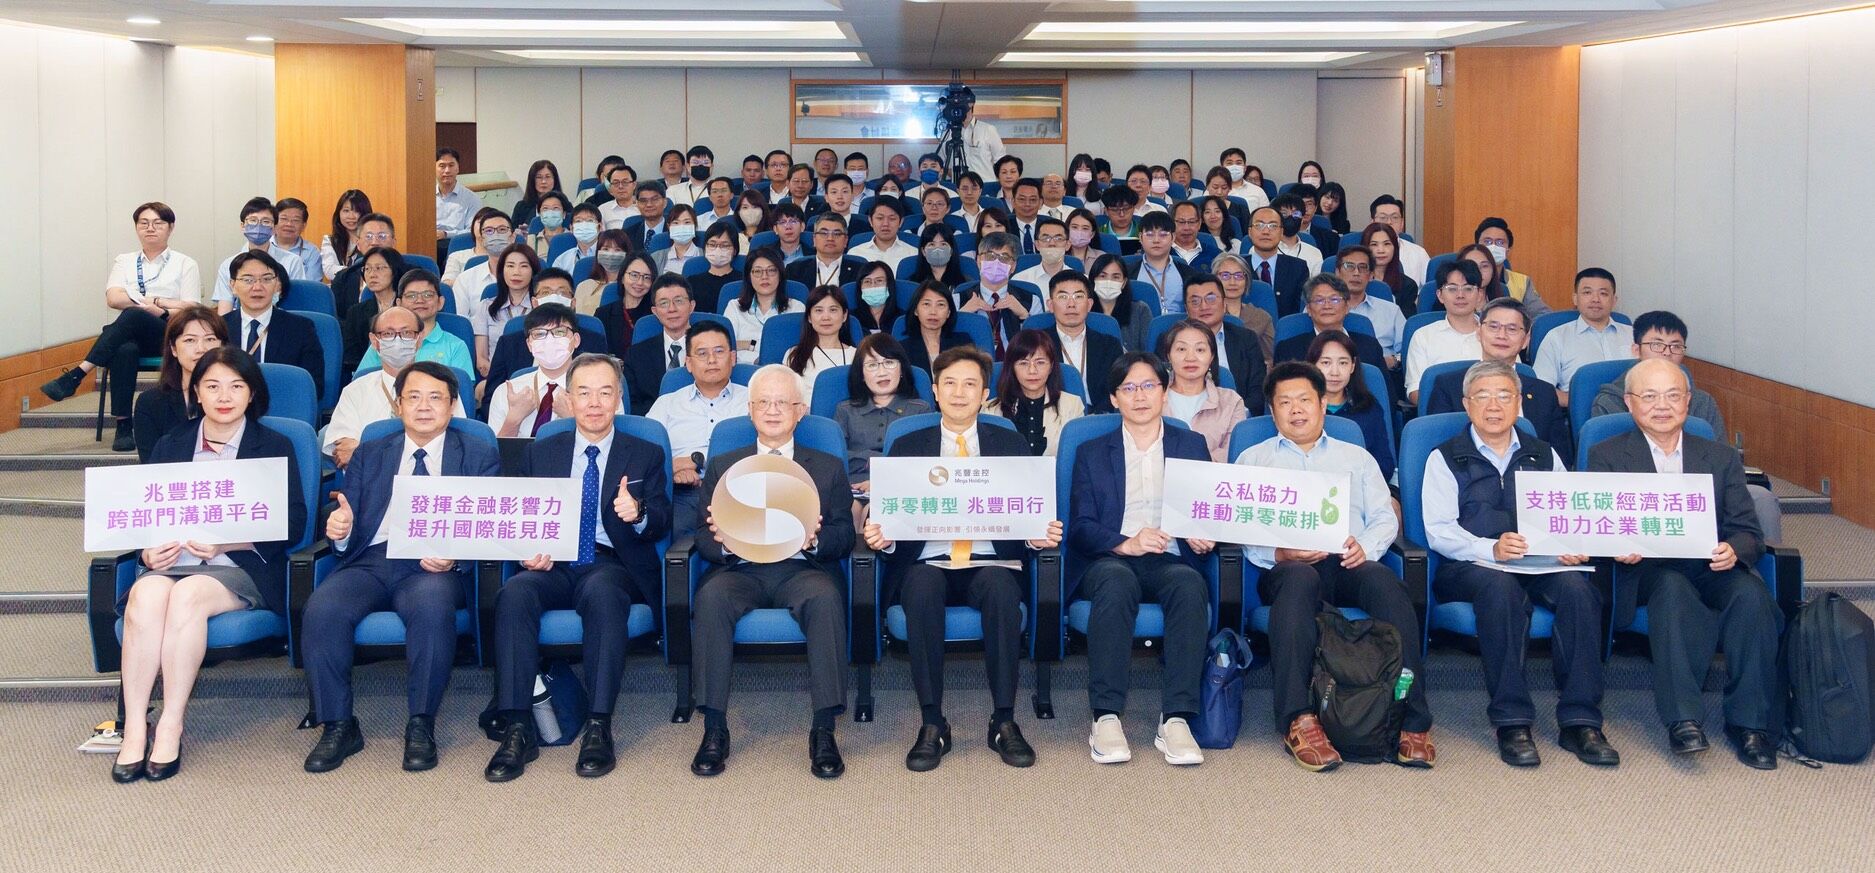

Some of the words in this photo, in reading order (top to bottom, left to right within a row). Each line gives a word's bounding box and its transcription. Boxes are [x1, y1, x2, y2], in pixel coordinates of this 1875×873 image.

[954, 469, 989, 477] 兆豐金控
[143, 478, 236, 503] 兆豐搭建
[1214, 481, 1298, 505] 公私協力
[1525, 490, 1707, 513] 支持低碳經濟活動
[107, 501, 270, 530] 跨部門溝通平台
[410, 495, 562, 516] 發揮金融影響力
[881, 496, 959, 515] 淨零轉型
[967, 496, 1045, 515] 兆豐同行
[1191, 500, 1320, 531] 推動淨零碳排
[408, 518, 561, 540] 提升國際能見度
[1549, 515, 1686, 537] 助力企業轉型
